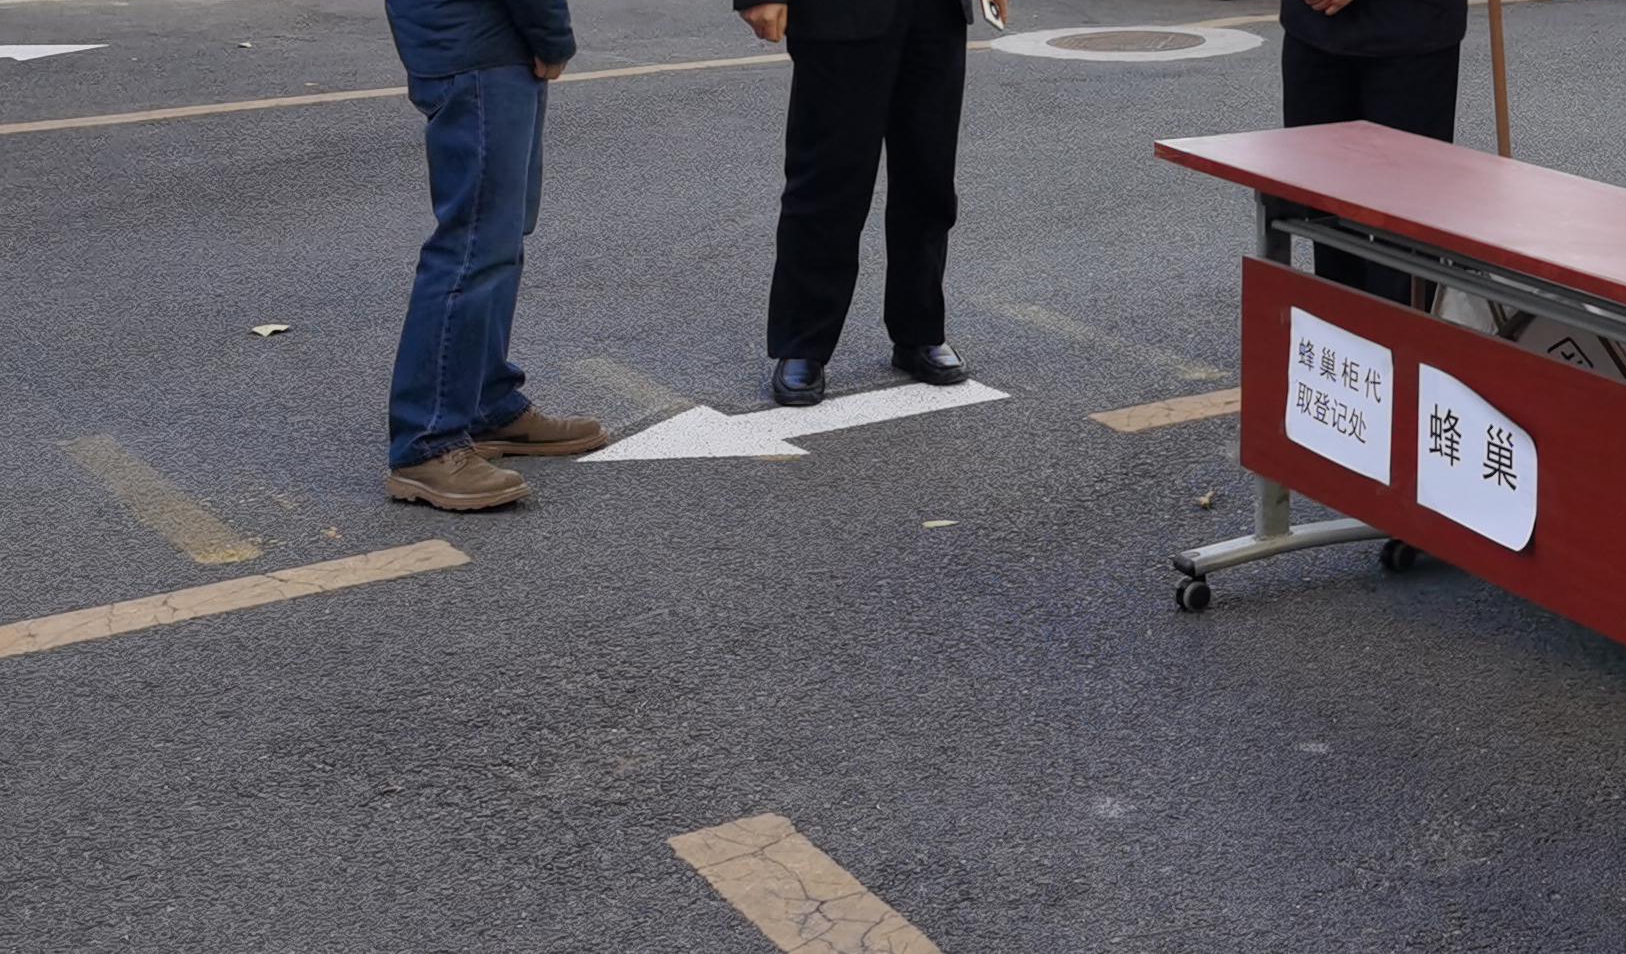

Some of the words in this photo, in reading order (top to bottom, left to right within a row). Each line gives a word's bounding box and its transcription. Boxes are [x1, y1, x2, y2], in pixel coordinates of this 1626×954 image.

[1298, 337, 1382, 403] 蜂巢柜代
[1296, 381, 1367, 444] 取登记处
[1429, 403, 1518, 491] 蜂巢
